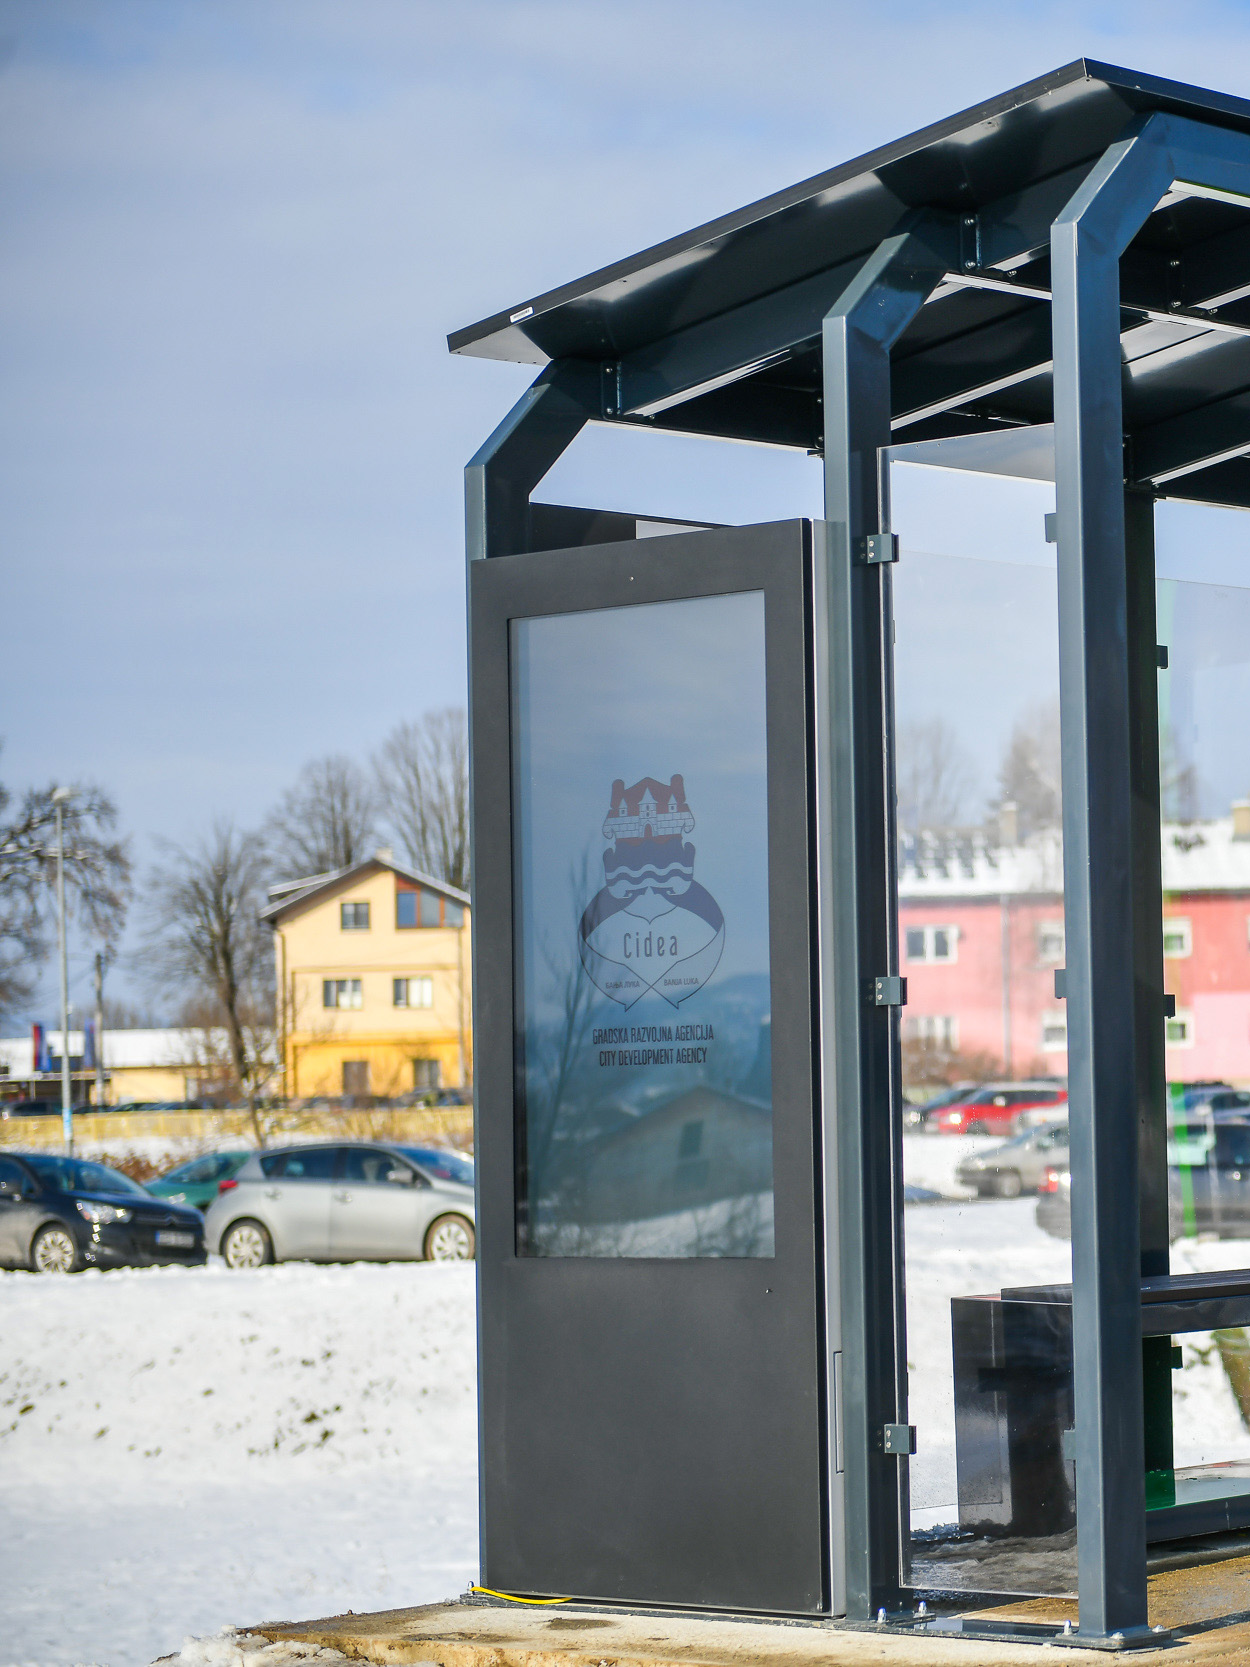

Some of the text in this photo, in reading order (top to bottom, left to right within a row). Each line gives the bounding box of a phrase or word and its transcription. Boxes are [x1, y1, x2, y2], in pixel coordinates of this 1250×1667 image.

[623, 932, 678, 958] Cidea
[593, 1024, 714, 1044] GRADSKA RAZVOJNA AGENCIJA
[599, 1048, 707, 1066] CITY DEVELOPMENT AGENCY
